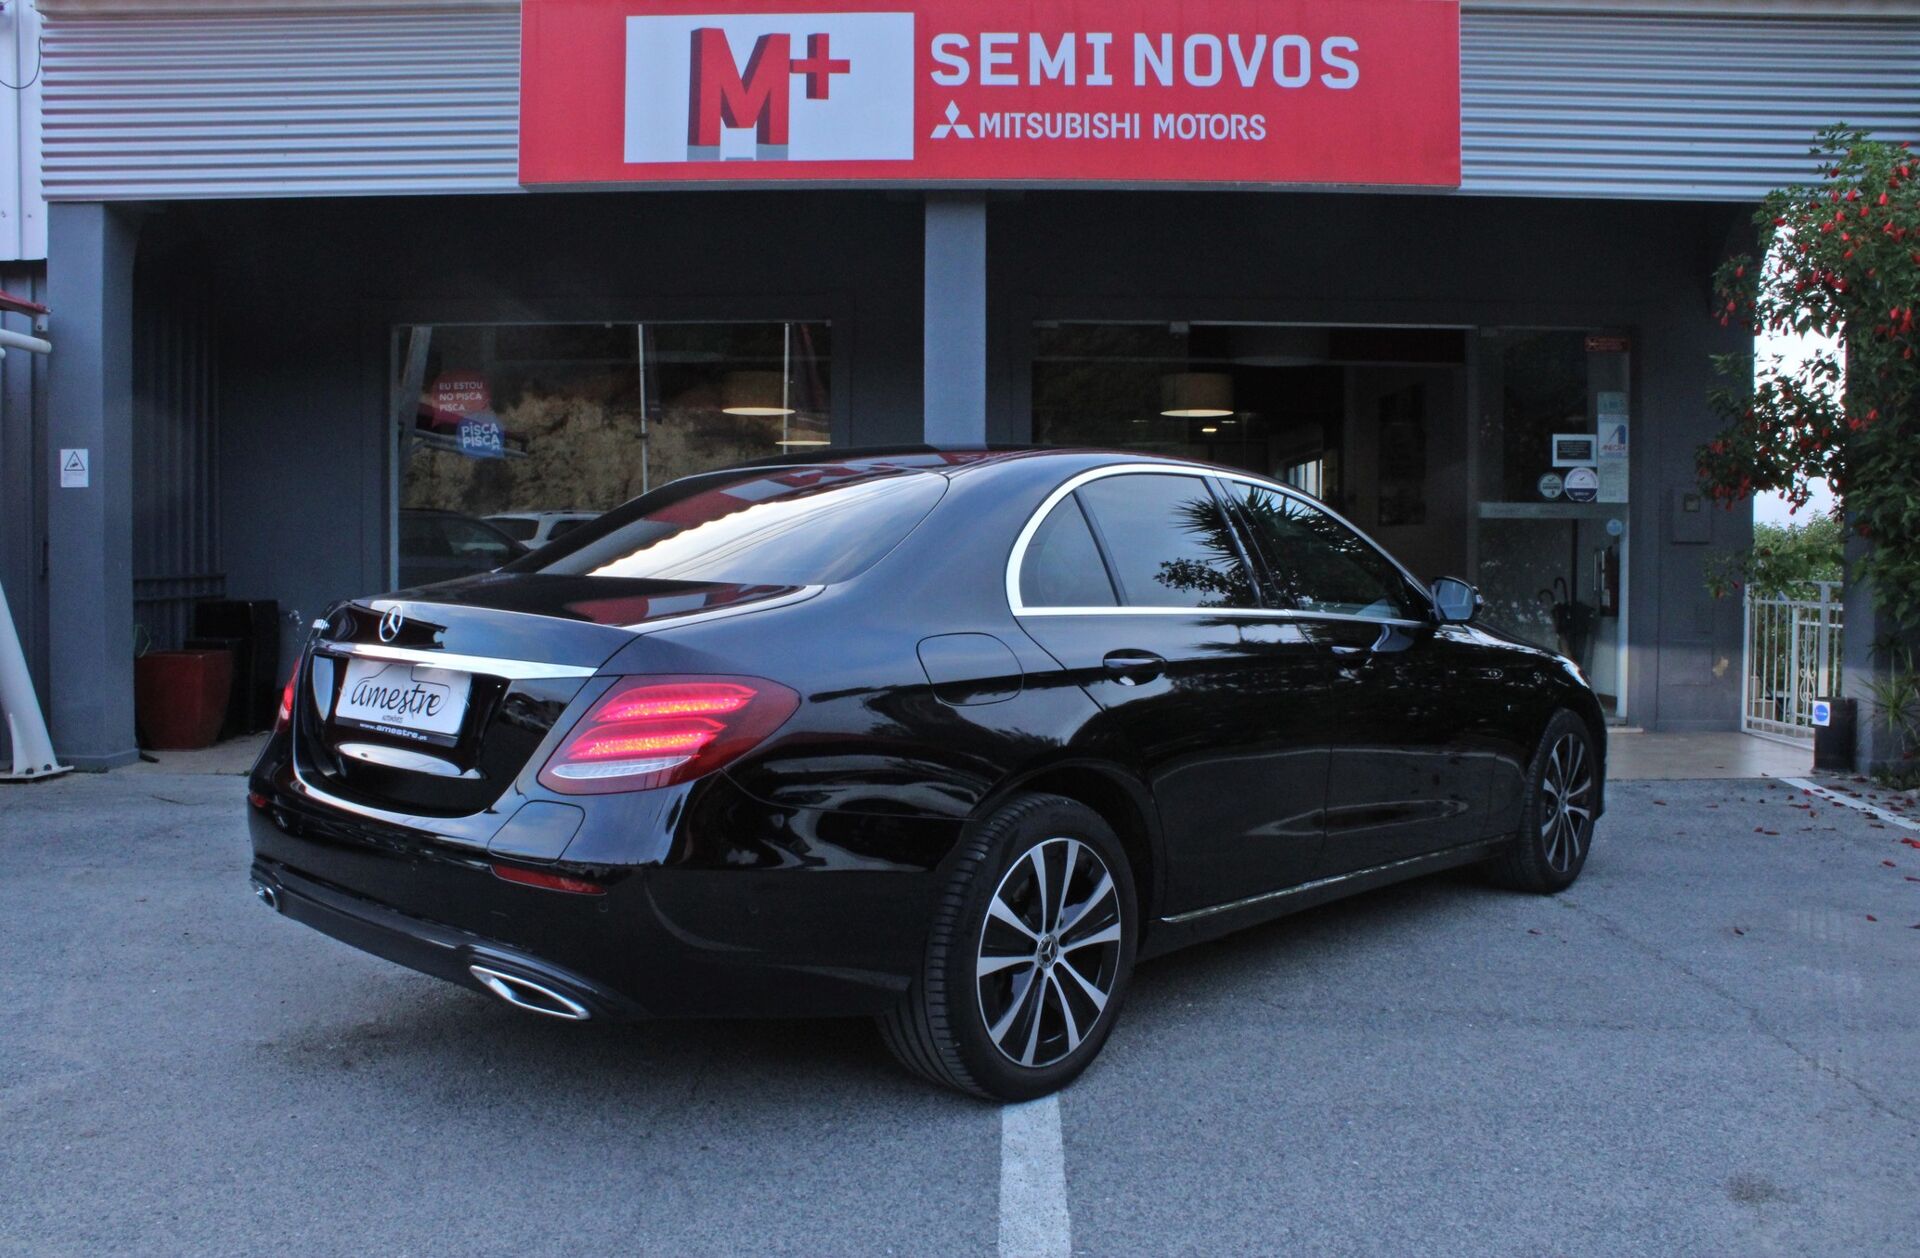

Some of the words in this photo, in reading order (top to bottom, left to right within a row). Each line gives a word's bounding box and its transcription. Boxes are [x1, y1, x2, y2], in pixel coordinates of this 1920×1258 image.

[930, 32, 1113, 86] SEMI
[1134, 32, 1360, 89] NOVOS
[979, 112, 1140, 139] MITSUBISHI
[1153, 113, 1267, 141] MOTORS
[453, 381, 483, 390] ESTOU
[439, 393, 454, 401] NO
[456, 391, 482, 400] PISCA
[439, 403, 465, 412] PISCA
[351, 680, 441, 717] amestre
[359, 722, 428, 741] www.amestre.pt
